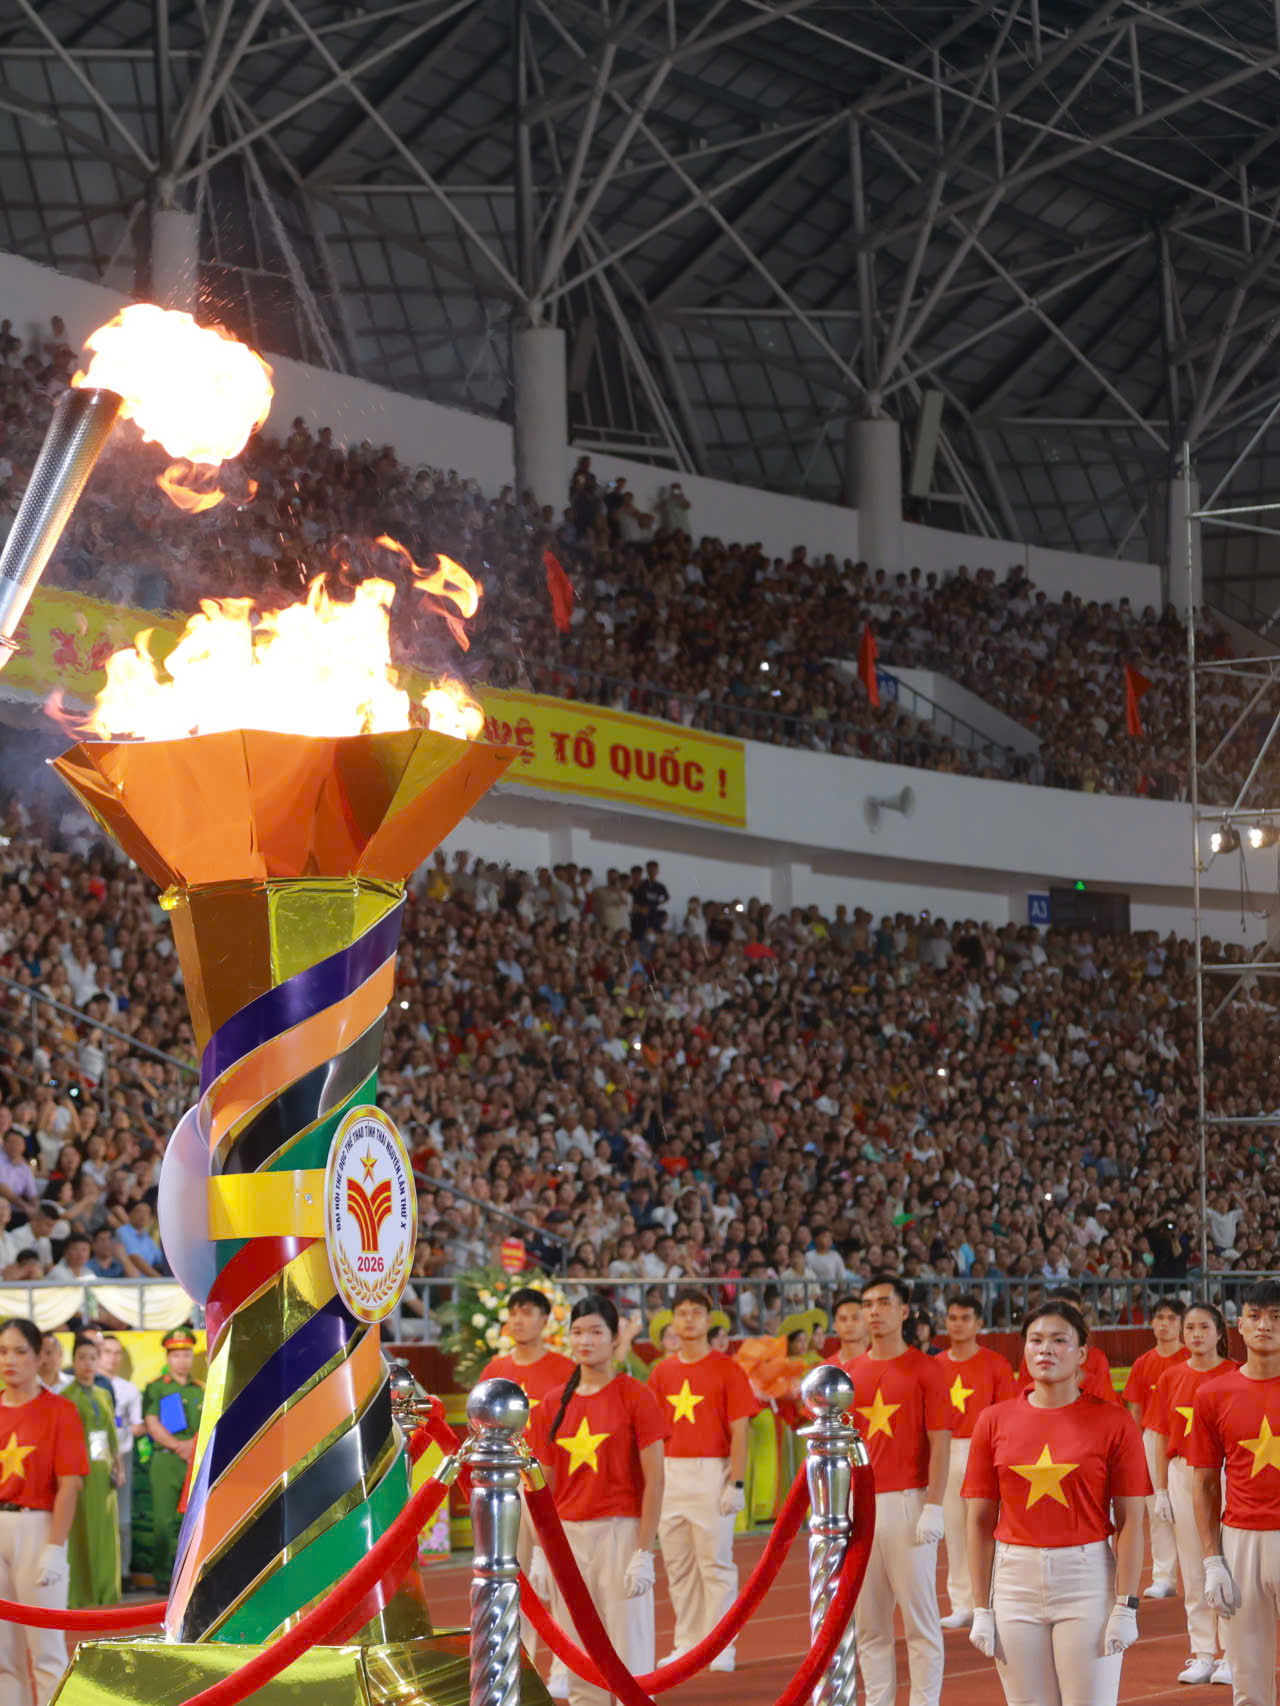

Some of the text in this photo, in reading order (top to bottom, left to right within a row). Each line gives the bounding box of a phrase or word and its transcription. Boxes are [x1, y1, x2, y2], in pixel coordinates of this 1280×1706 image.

[550, 724, 598, 770] TỔ
[609, 746, 705, 793] QUỐC
[717, 767, 728, 799] !
[357, 1255, 385, 1273] 2026
